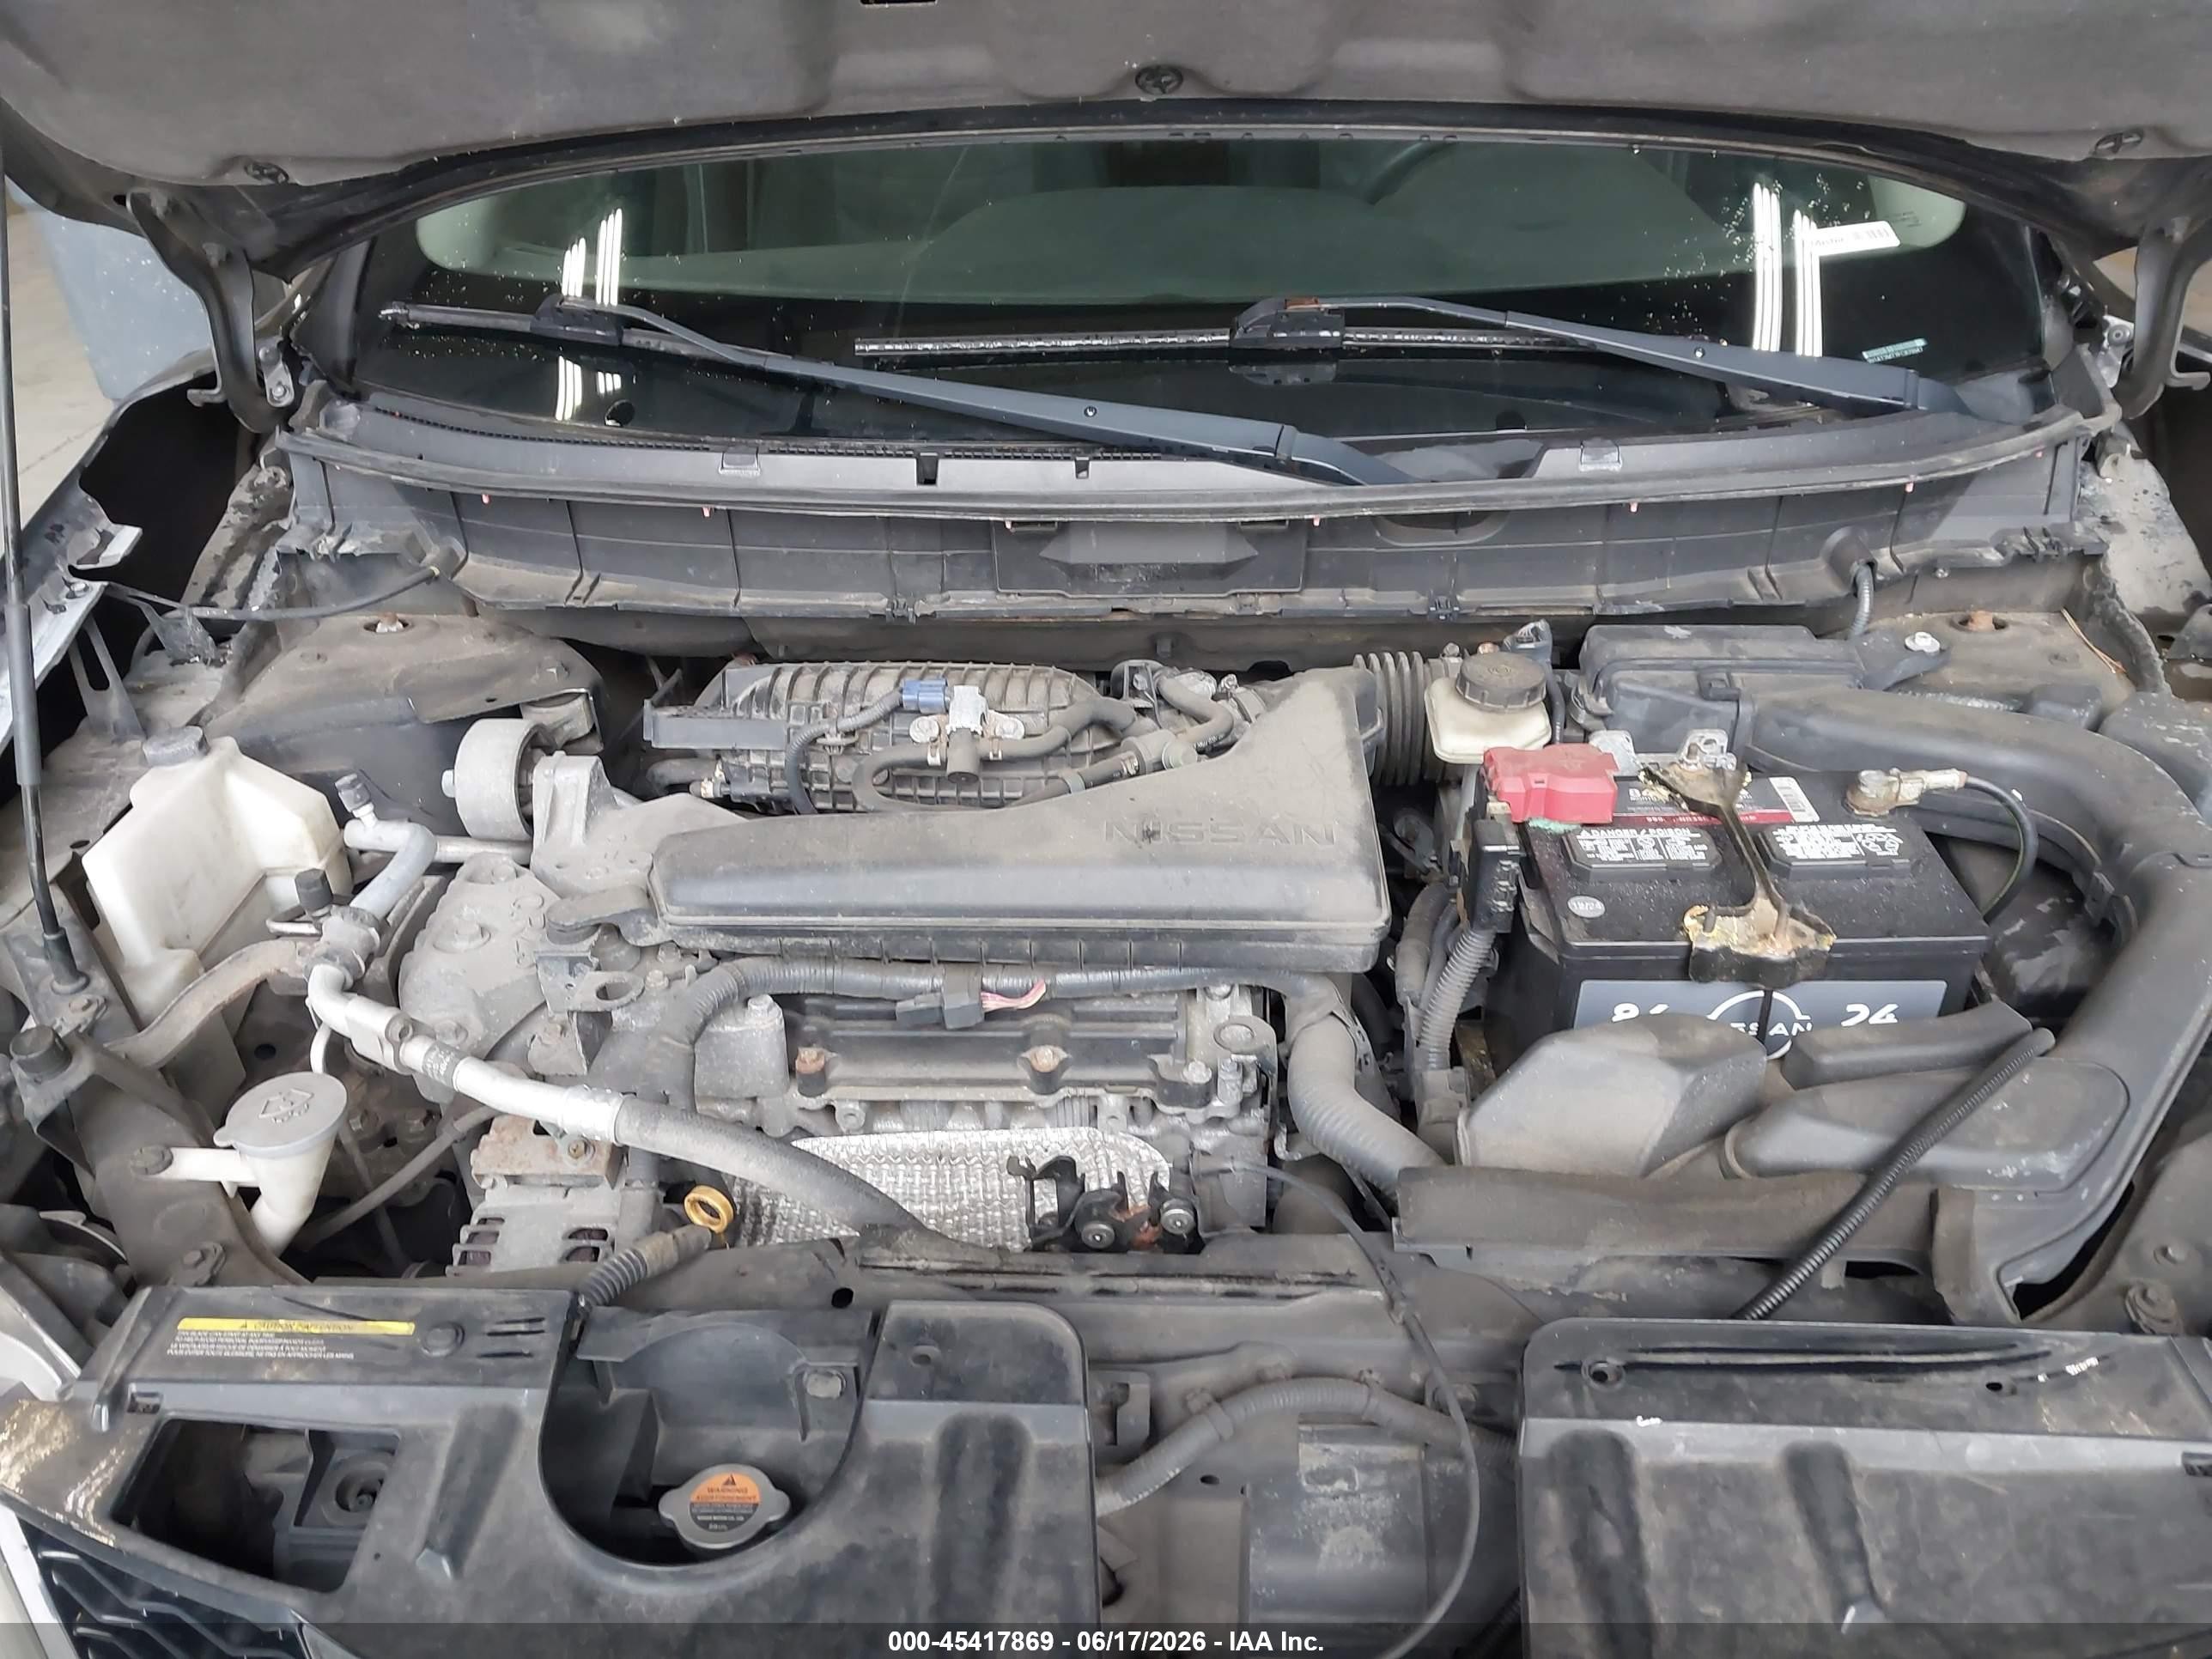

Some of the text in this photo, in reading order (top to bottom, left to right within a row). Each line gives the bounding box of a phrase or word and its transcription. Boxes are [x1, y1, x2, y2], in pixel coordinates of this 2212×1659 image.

[1103, 820, 1336, 845] NISSAN
[1590, 828, 1637, 837] DANGER
[1649, 827, 1690, 836] POISON
[1841, 1004, 1899, 1027] 24
